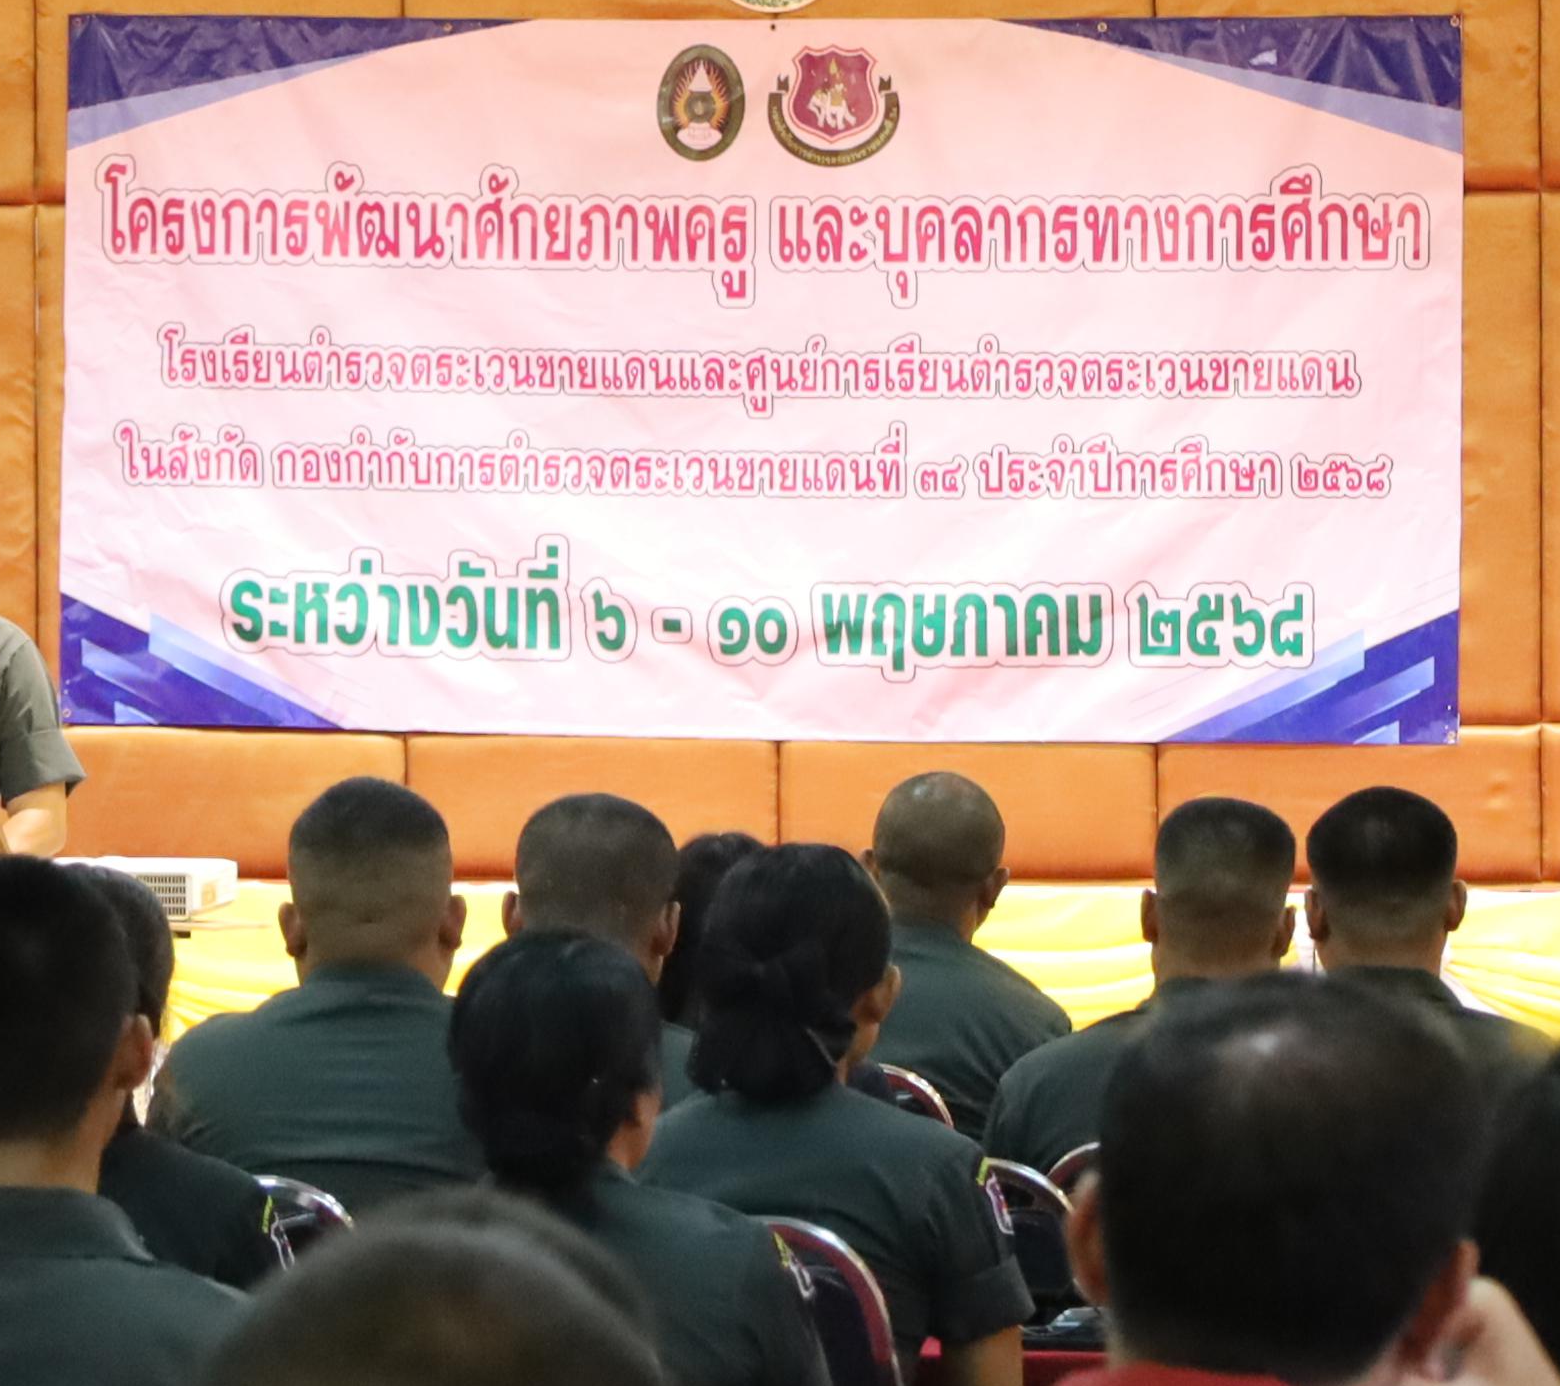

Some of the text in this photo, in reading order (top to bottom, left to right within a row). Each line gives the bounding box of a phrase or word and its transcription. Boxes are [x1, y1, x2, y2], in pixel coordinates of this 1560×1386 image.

[103, 162, 1422, 300] โครงการพัฒนาศักยภาพครู และบุคลากรทางการศึกษา
[164, 328, 1355, 412] โรงเรียนตำรวจตระเวนชายแดนและศูนย์การเรียนตำรวจตระเวนชายแดน
[121, 426, 1386, 494] ในสังกัด กองกำกับการตำรวจตระเวนชายแดนที่ ๓๔ ประจำปีการศึกษา ๒๕๖๘
[231, 545, 561, 651] ระหว่างวันที่
[593, 590, 626, 651] ๖
[718, 606, 787, 656] ๑๐
[821, 593, 1102, 672] พฤษภาคม
[1137, 594, 1304, 657] ๒๕๖๘
